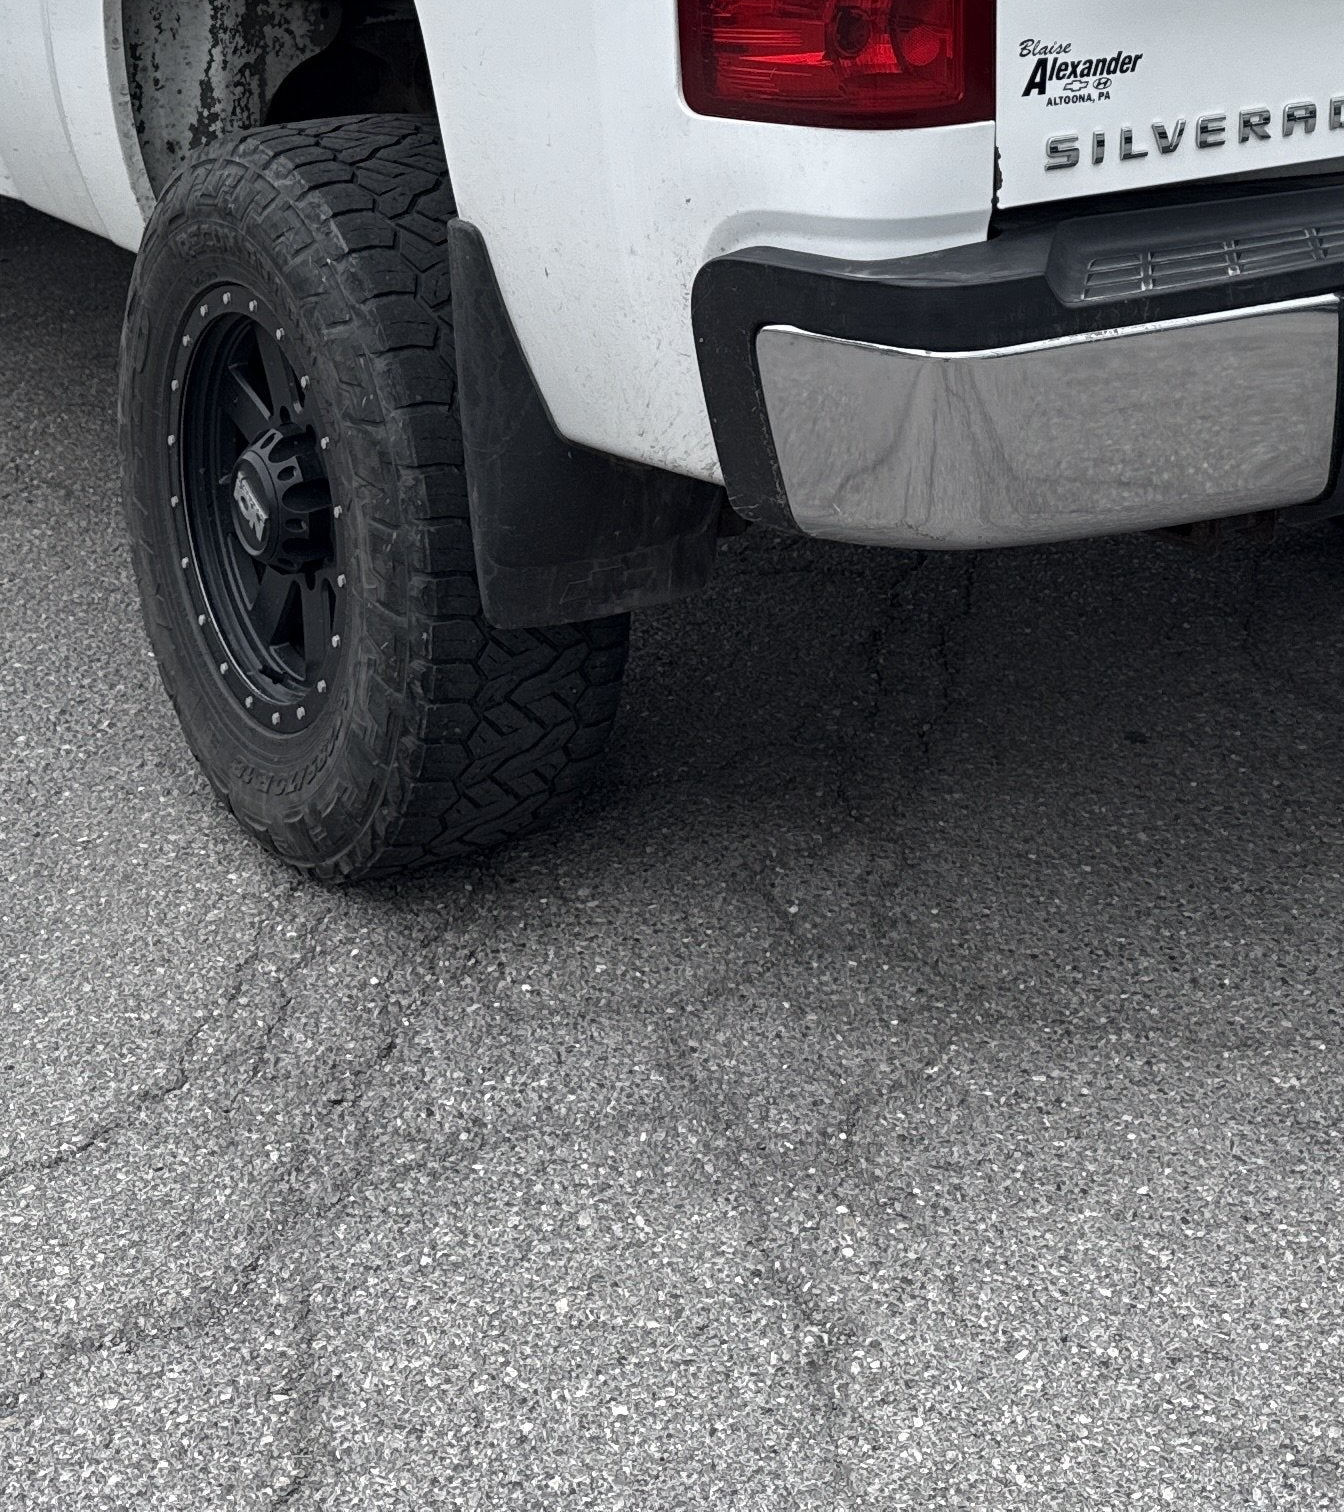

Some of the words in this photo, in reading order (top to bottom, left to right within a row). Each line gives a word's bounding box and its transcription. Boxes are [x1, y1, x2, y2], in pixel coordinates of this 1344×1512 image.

[1017, 37, 1073, 58] Blaise
[1020, 49, 1144, 97] Alexander
[1045, 93, 1096, 108] ALTOONA,
[1097, 90, 1111, 102] PA
